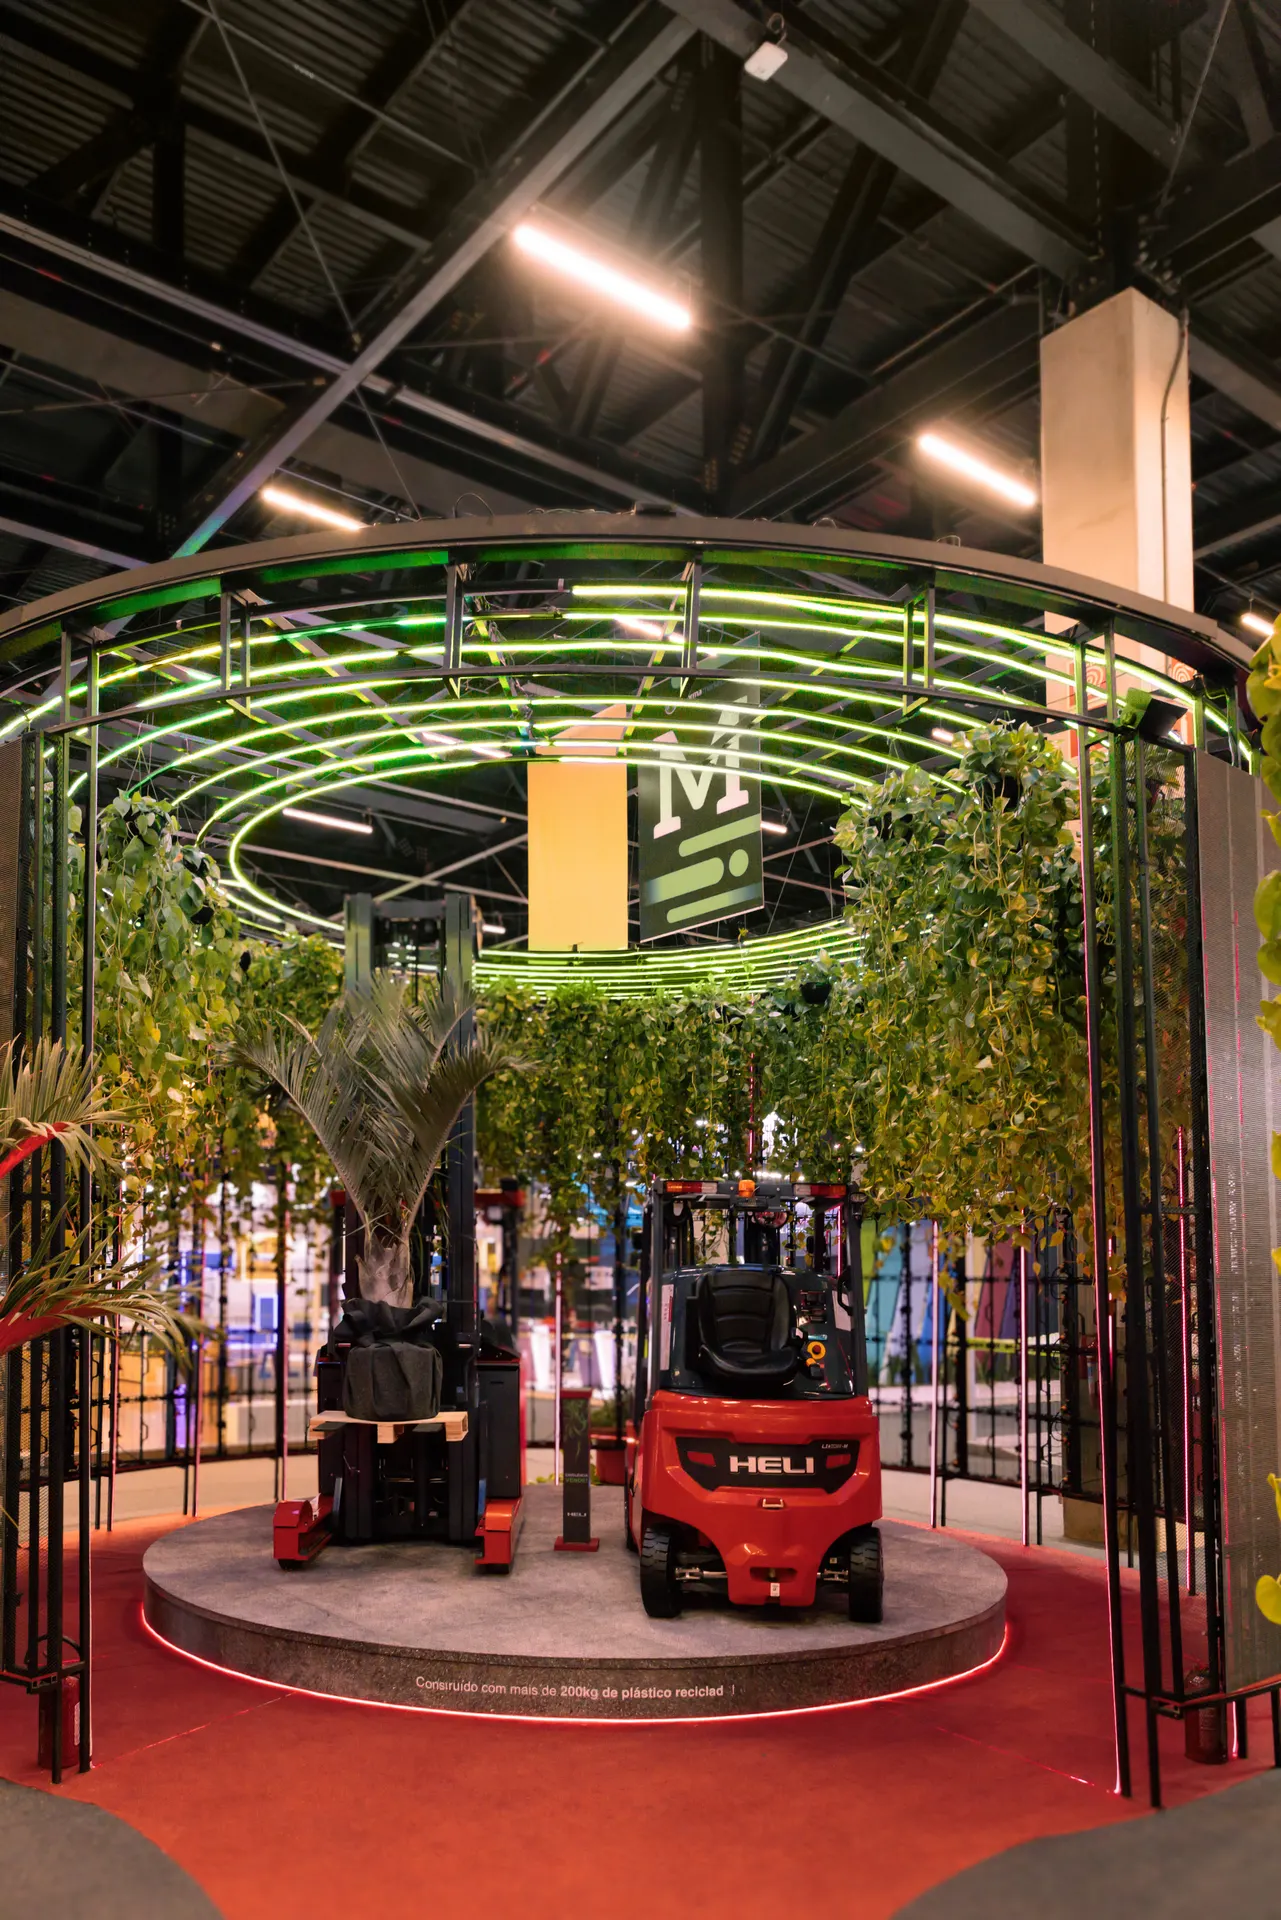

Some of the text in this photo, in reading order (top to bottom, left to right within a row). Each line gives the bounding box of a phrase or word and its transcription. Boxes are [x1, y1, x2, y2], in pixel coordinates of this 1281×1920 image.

[729, 1455, 814, 1474] HELI
[481, 1683, 507, 1694] com
[509, 1684, 539, 1696] mais
[541, 1685, 557, 1697] de
[560, 1685, 599, 1700] 200kg
[602, 1686, 618, 1699] de
[621, 1686, 672, 1700] plástico
